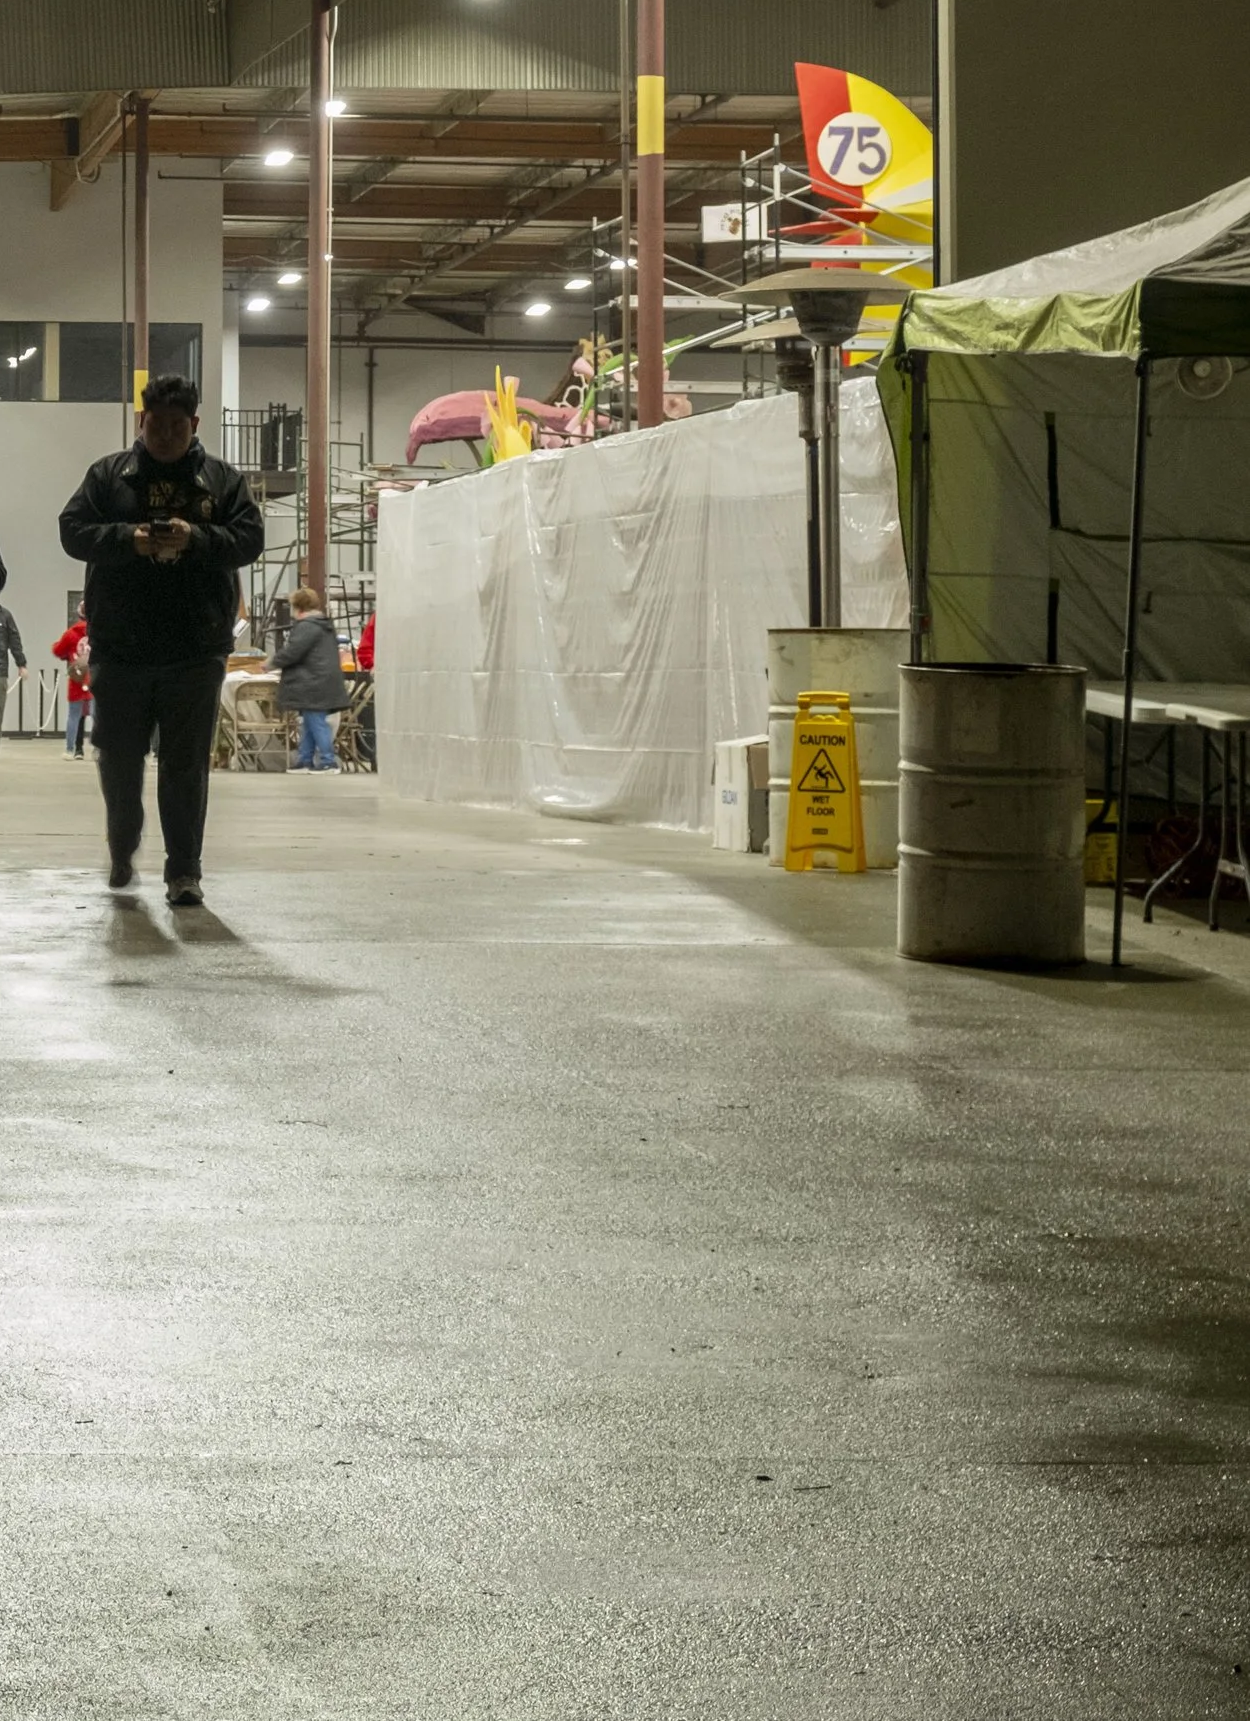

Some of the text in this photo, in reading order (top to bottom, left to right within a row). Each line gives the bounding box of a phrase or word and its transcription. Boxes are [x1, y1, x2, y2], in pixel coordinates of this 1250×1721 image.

[828, 126, 887, 175] 75
[799, 735, 846, 746] CAUTION
[812, 795, 830, 804] WET
[807, 807, 835, 816] FLOOR
